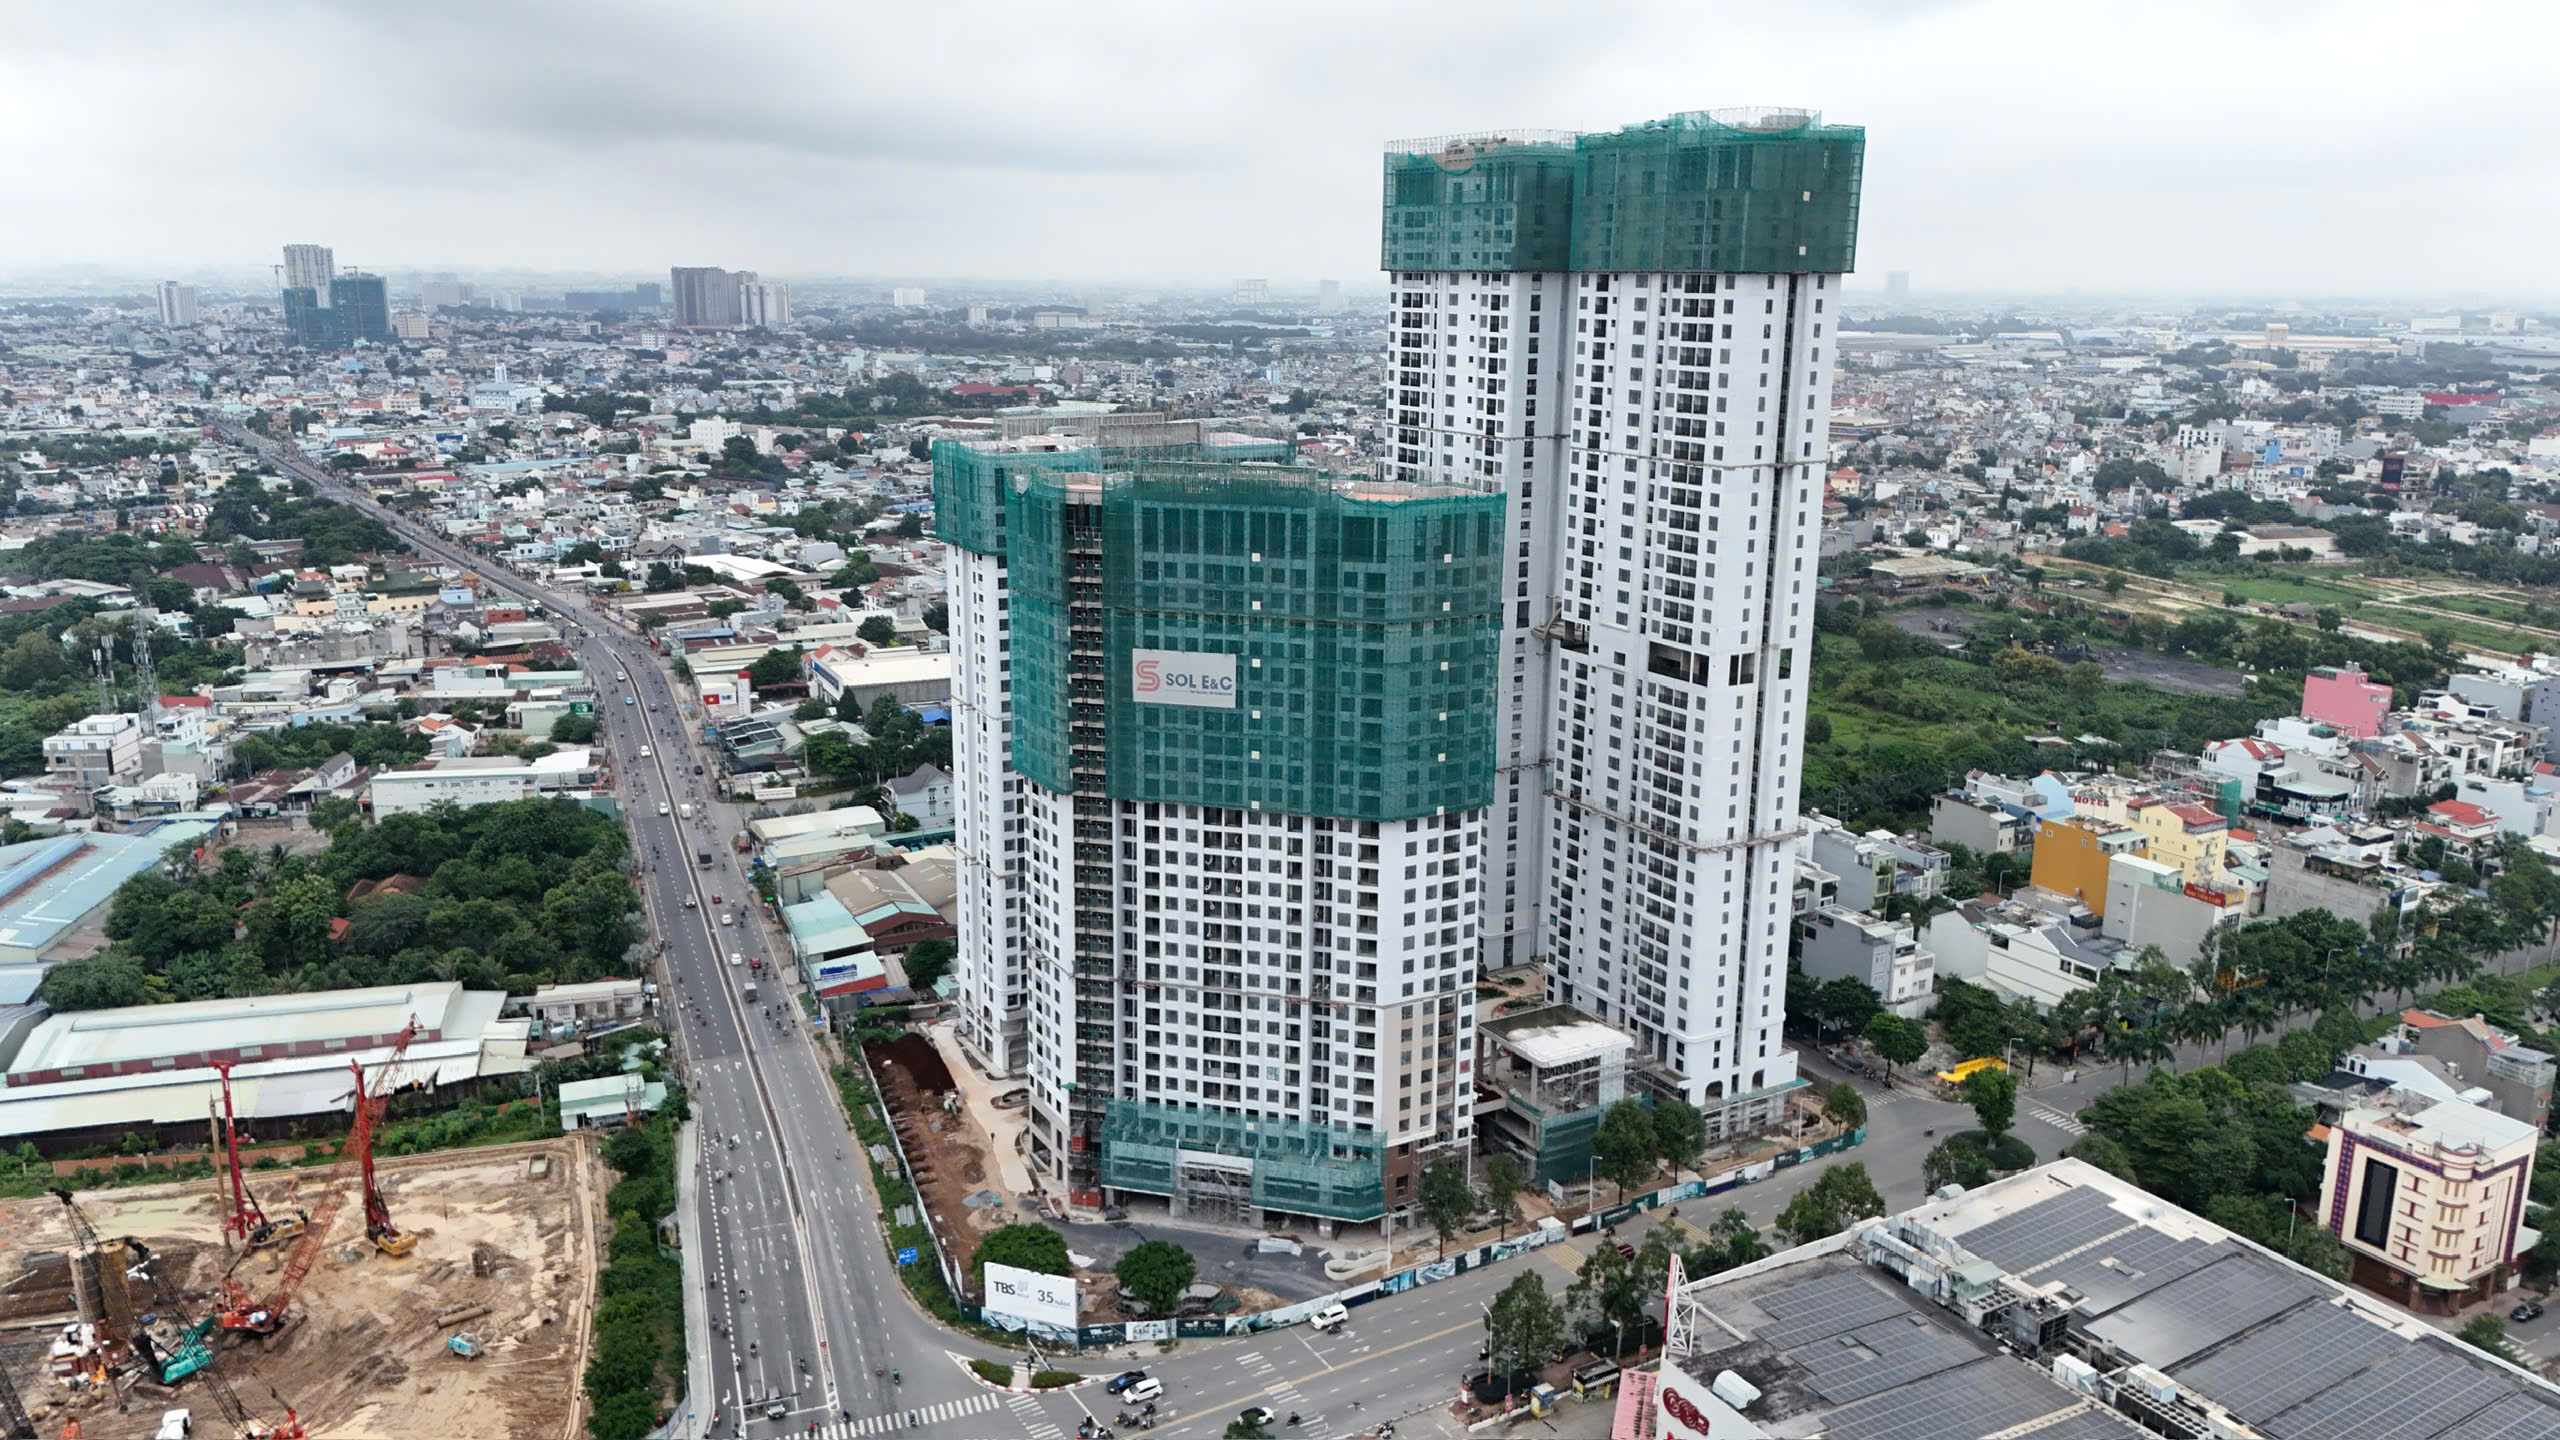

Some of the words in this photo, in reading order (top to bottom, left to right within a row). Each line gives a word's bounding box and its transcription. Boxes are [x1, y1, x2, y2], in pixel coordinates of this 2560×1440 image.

[1166, 673, 1197, 688] SOL
[1202, 675, 1233, 690] E&C
[993, 1281, 1016, 1295] TBS
[1037, 1289, 1054, 1303] 35
